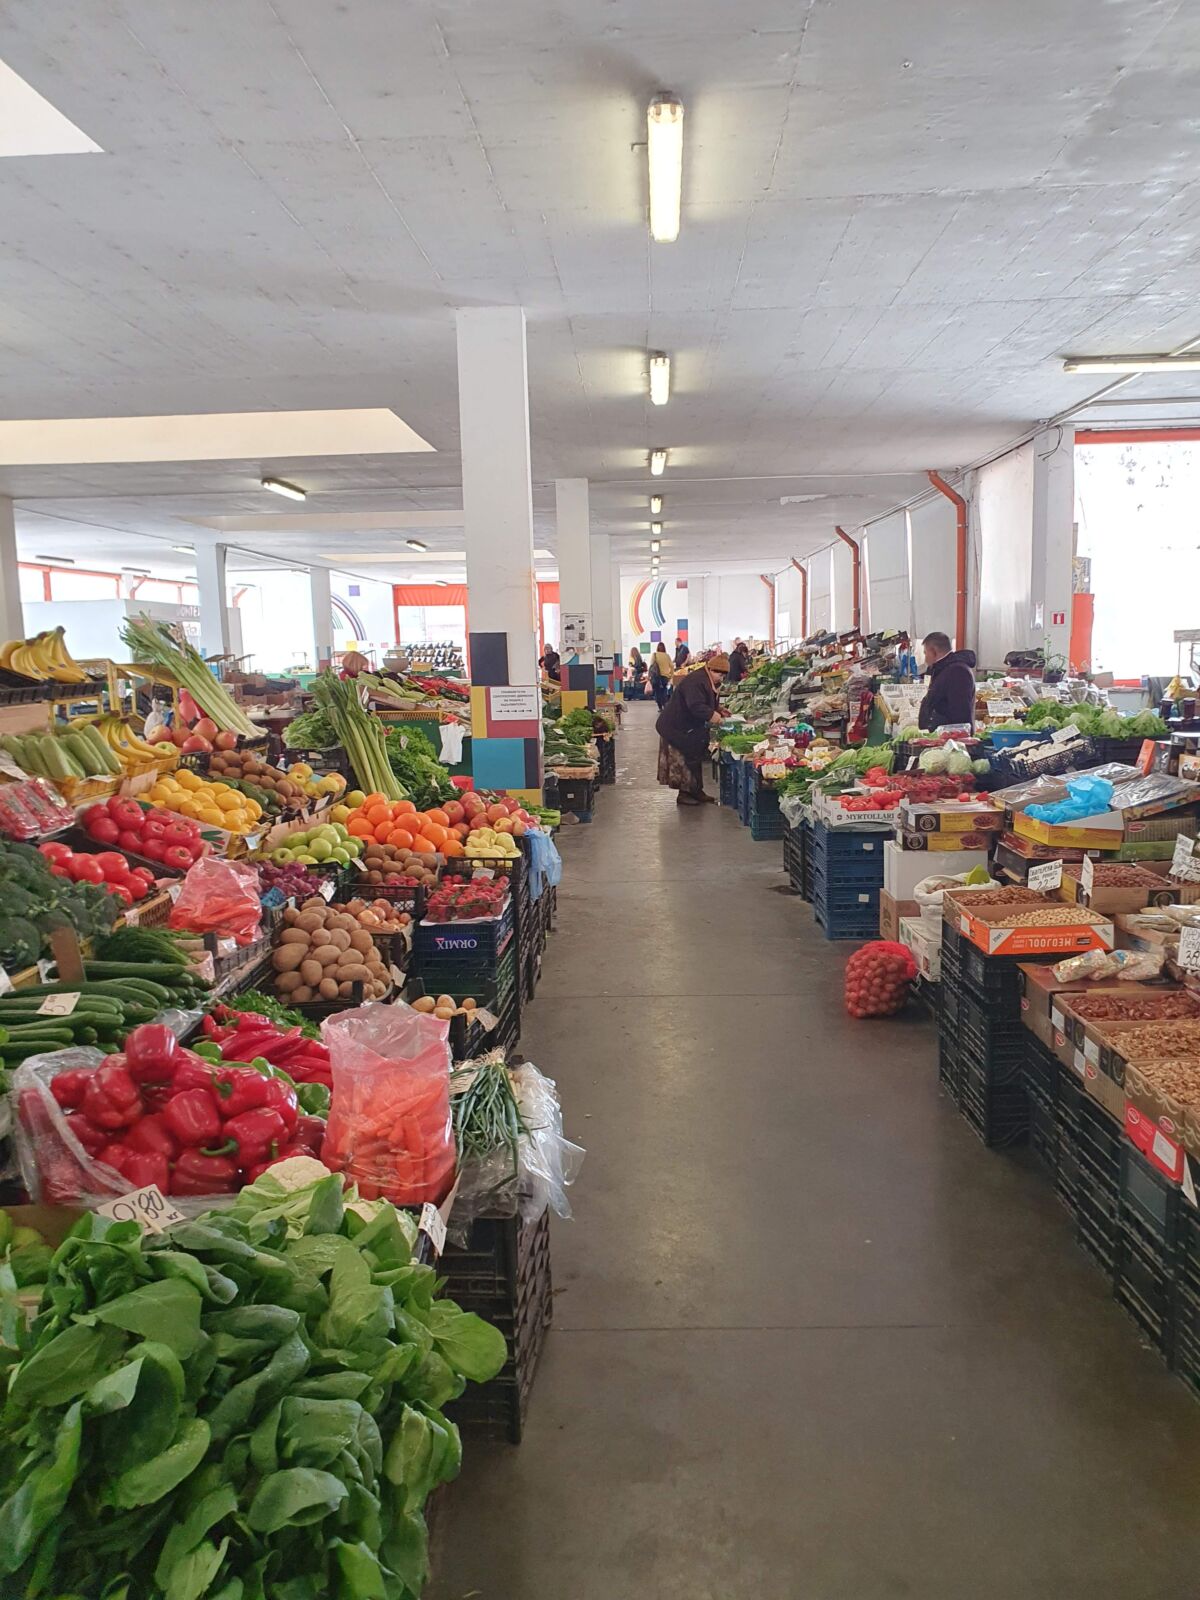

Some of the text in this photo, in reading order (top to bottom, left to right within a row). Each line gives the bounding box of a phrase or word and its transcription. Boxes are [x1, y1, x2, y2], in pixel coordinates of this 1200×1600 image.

[846, 813, 895, 821] MYRTOLLARI
[437, 939, 478, 950] ORMIX
[1029, 937, 1073, 948] MEDJOOL
